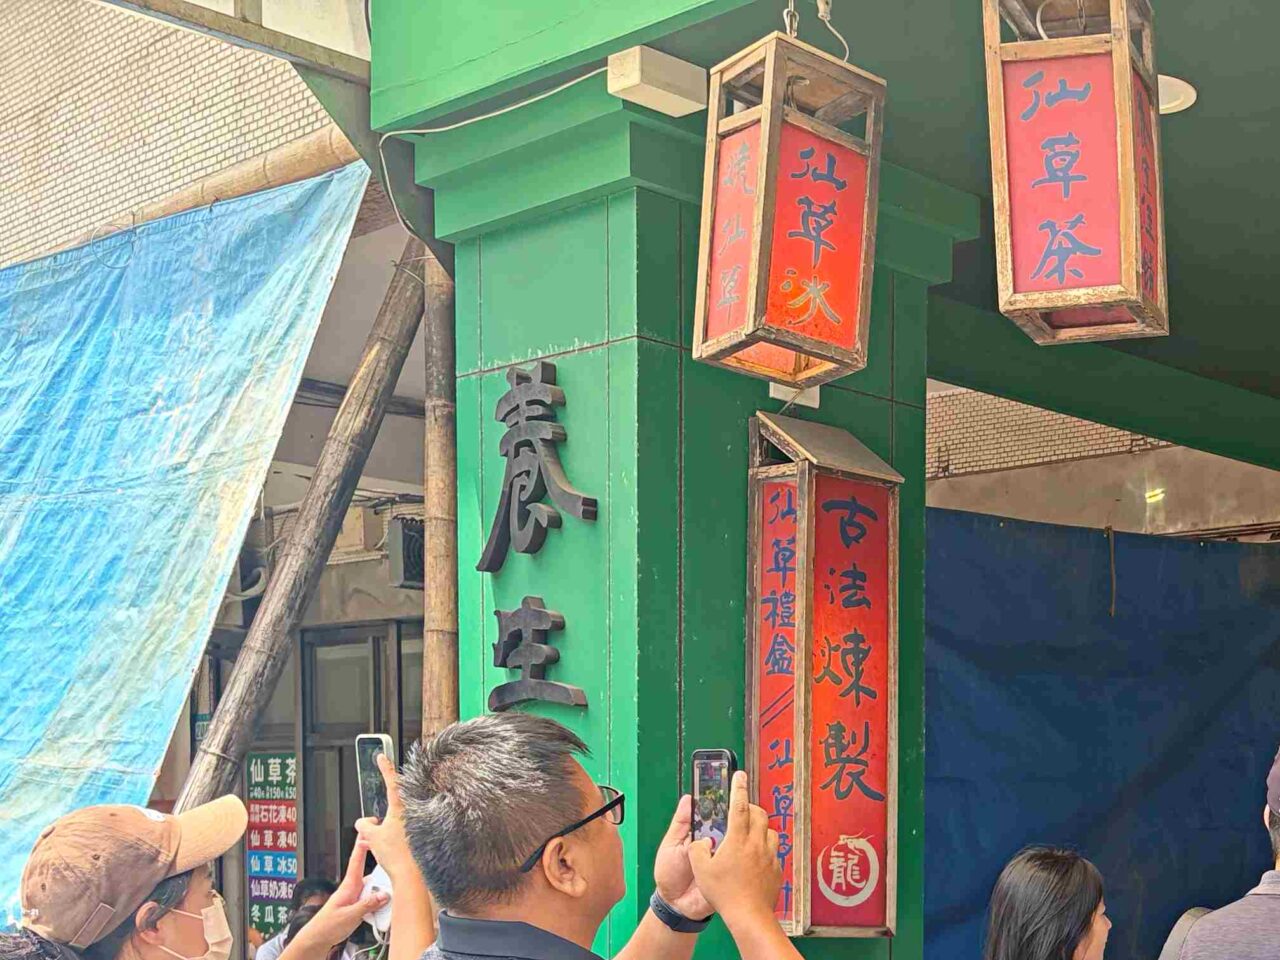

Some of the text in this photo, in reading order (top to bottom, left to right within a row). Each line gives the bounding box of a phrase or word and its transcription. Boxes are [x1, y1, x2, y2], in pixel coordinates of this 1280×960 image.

[1021, 69, 1103, 284] 仙草茶
[787, 146, 849, 326] 仙草冰
[250, 880, 296, 899] 仙草奶凍6
[828, 850, 866, 891] 龍
